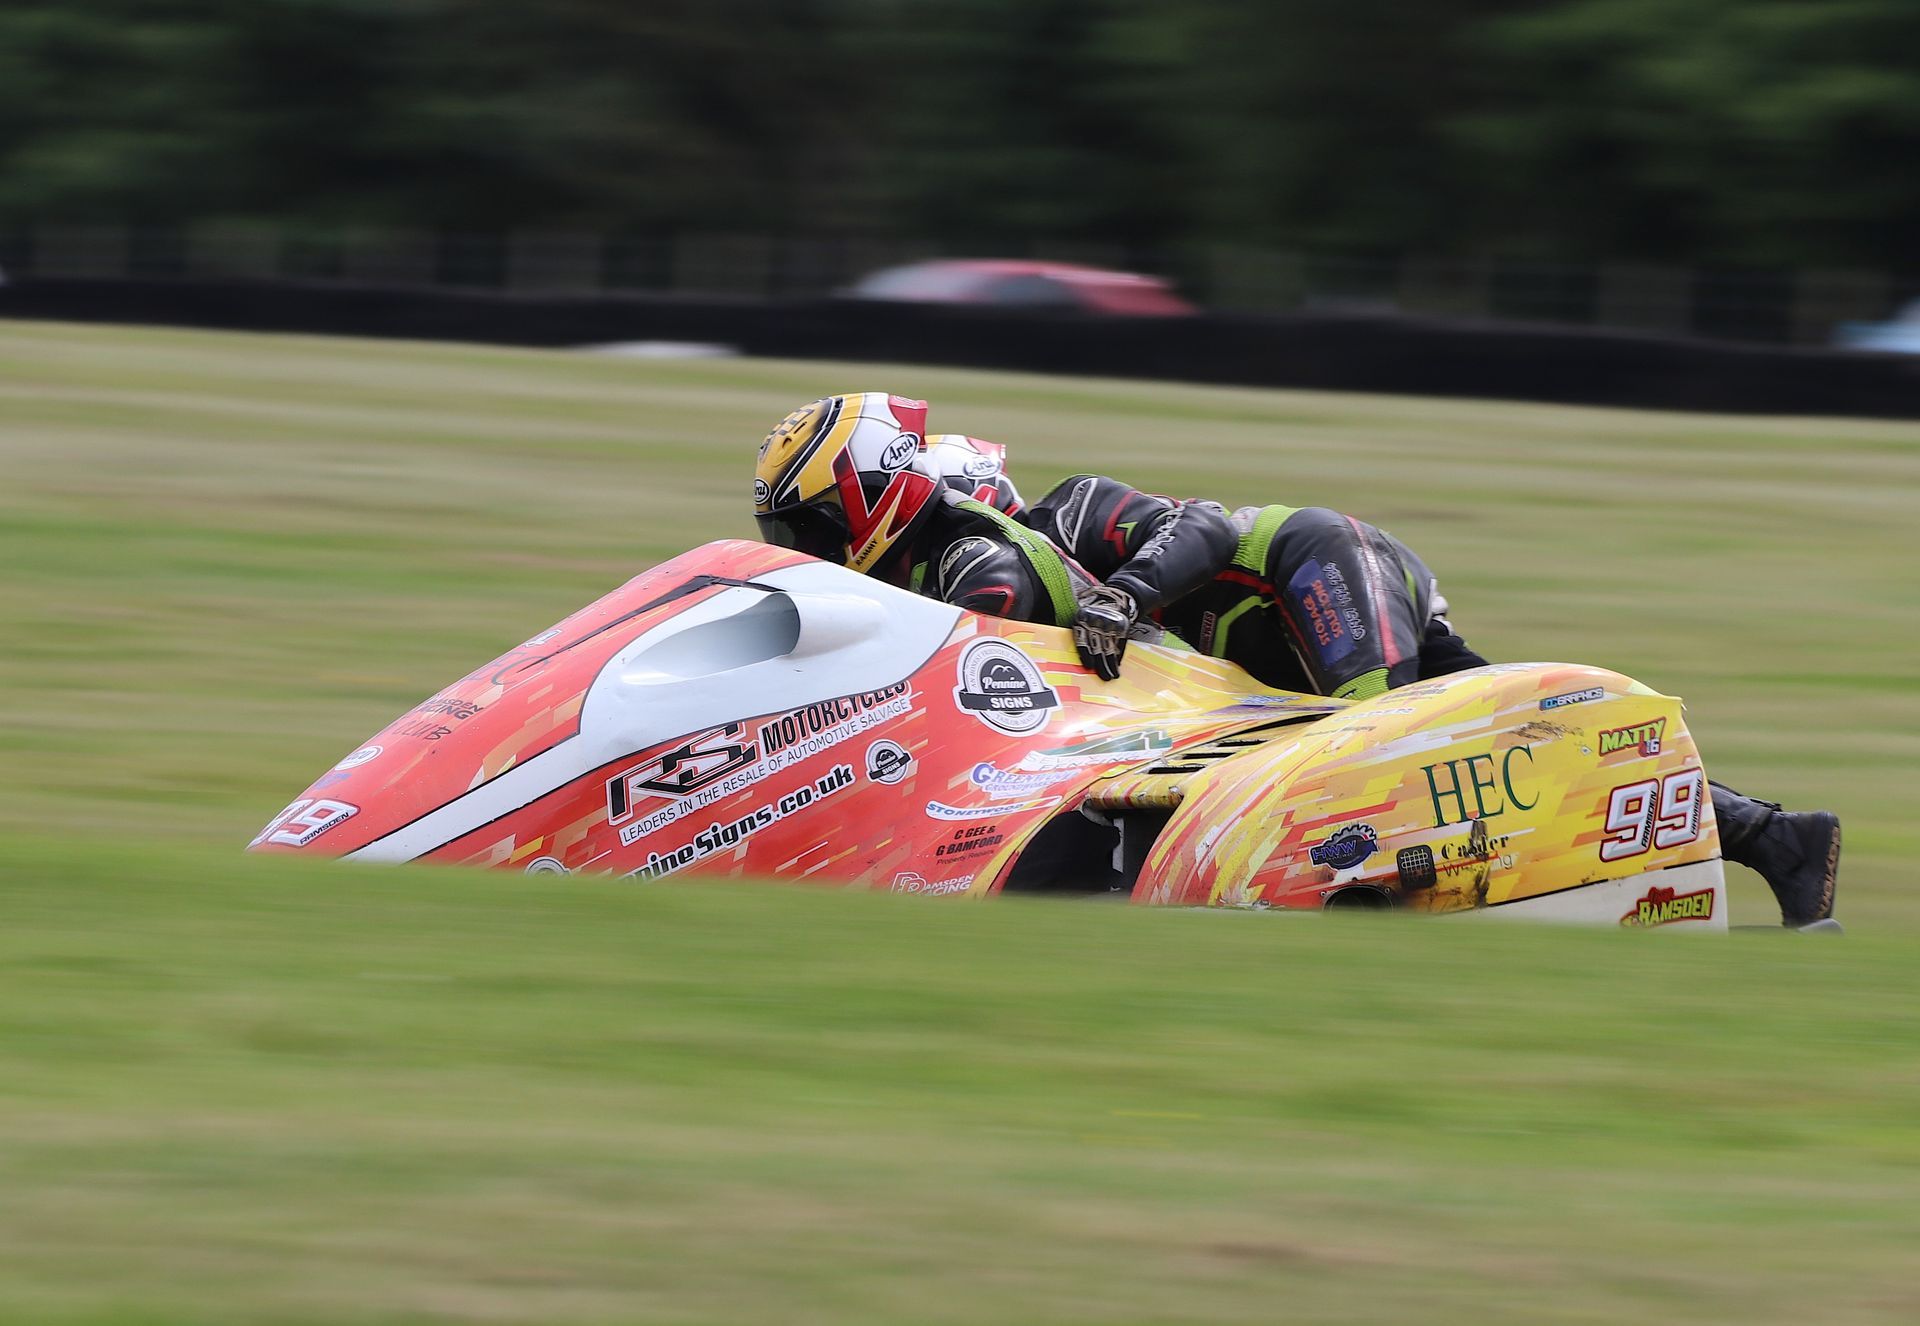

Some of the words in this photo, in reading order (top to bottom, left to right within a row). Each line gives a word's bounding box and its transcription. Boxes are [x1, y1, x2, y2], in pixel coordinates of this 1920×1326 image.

[885, 438, 913, 469] Arai
[1303, 593, 1331, 646] STORAGE
[1311, 579, 1345, 639] SOLUTIONS
[982, 676, 1027, 690] Pennine
[990, 696, 1034, 709] SIGNS
[1600, 719, 1665, 754] MATTY
[622, 807, 676, 842] LEADERS
[679, 798, 693, 814] IN
[695, 786, 720, 806] THE
[722, 764, 765, 795] RESALE
[768, 756, 784, 771] OF
[787, 721, 859, 764] AUTOMOTIVE
[859, 698, 908, 728] SALVAGE
[881, 761, 901, 775] SIGNS
[1420, 744, 1540, 829] HEC
[300, 811, 350, 845] RAMSDEN
[1600, 767, 1704, 862] 99
[936, 845, 946, 857] G
[946, 834, 1003, 855] BAMFORD
[953, 829, 964, 840] C
[965, 826, 986, 838] GEE
[1313, 839, 1357, 861] HWW
[1638, 891, 1713, 926] RAMSDEN
